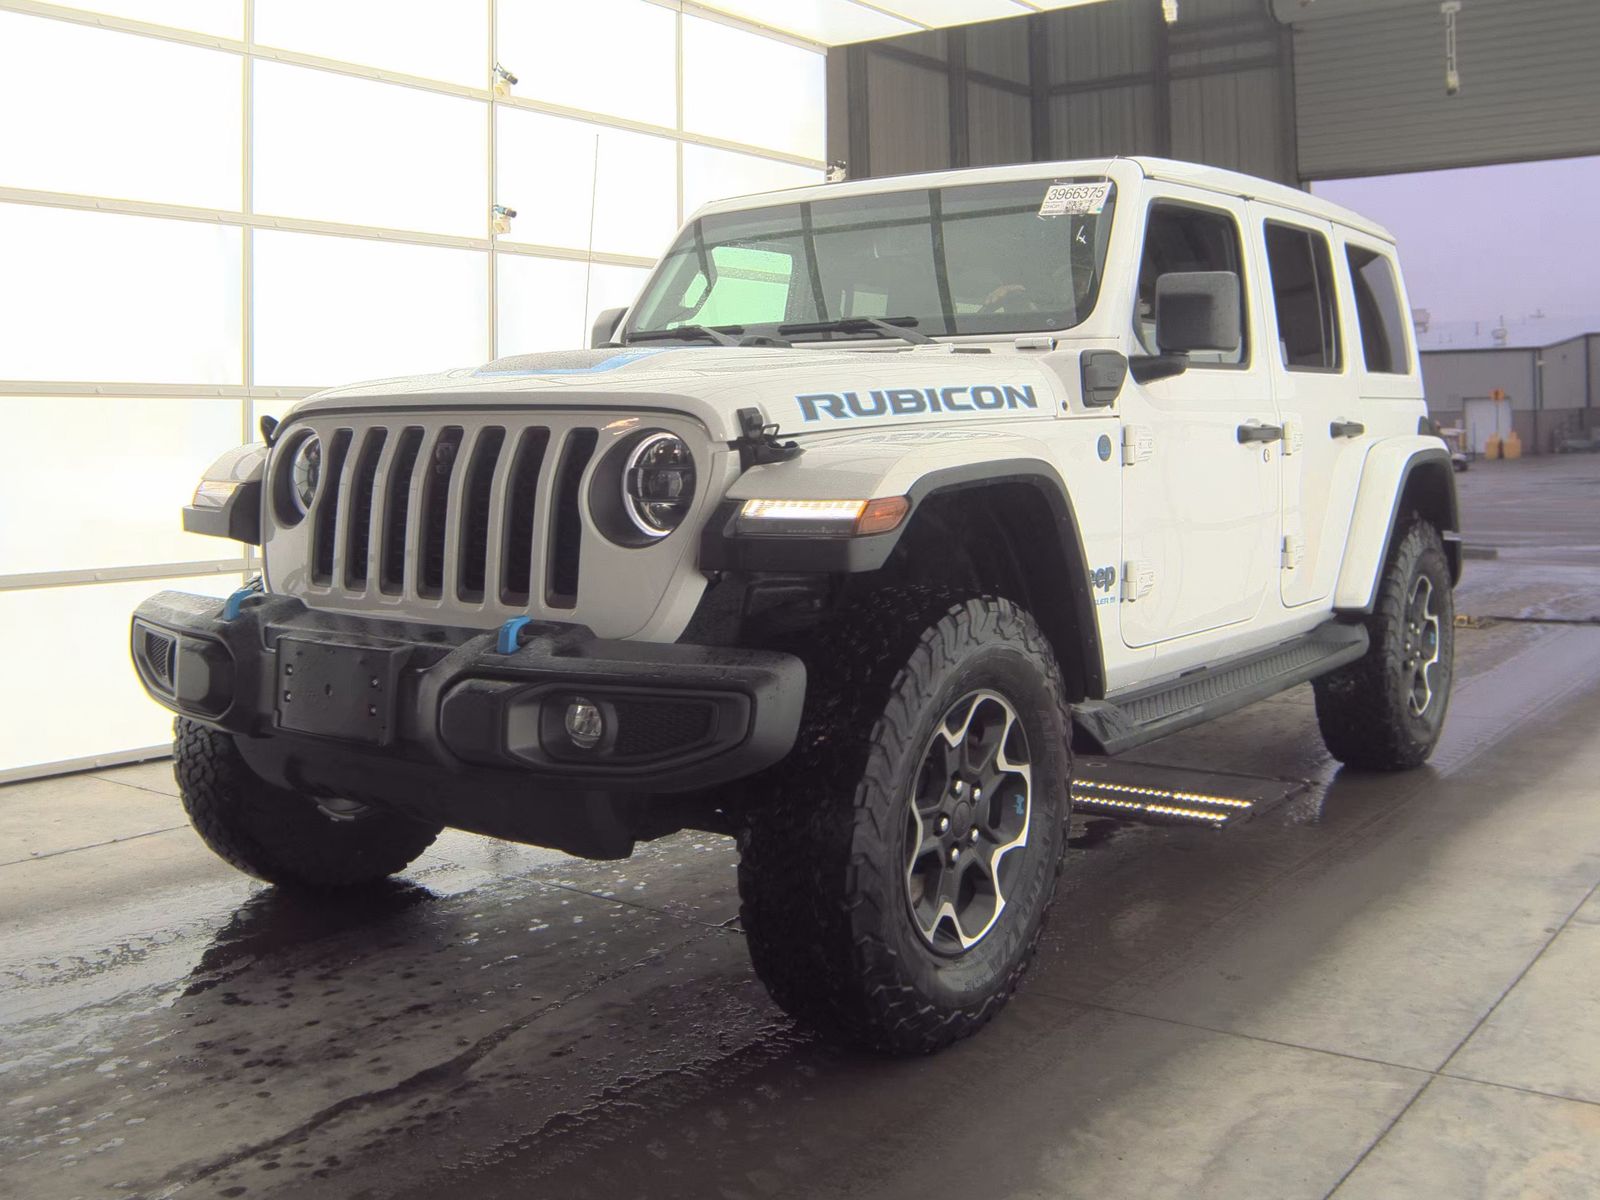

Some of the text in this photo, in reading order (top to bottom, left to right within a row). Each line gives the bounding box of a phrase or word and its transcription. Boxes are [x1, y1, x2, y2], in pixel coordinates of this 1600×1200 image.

[1048, 187, 1106, 201] 3966375
[796, 385, 1038, 422] RUBICON
[1088, 566, 1116, 592] eep
